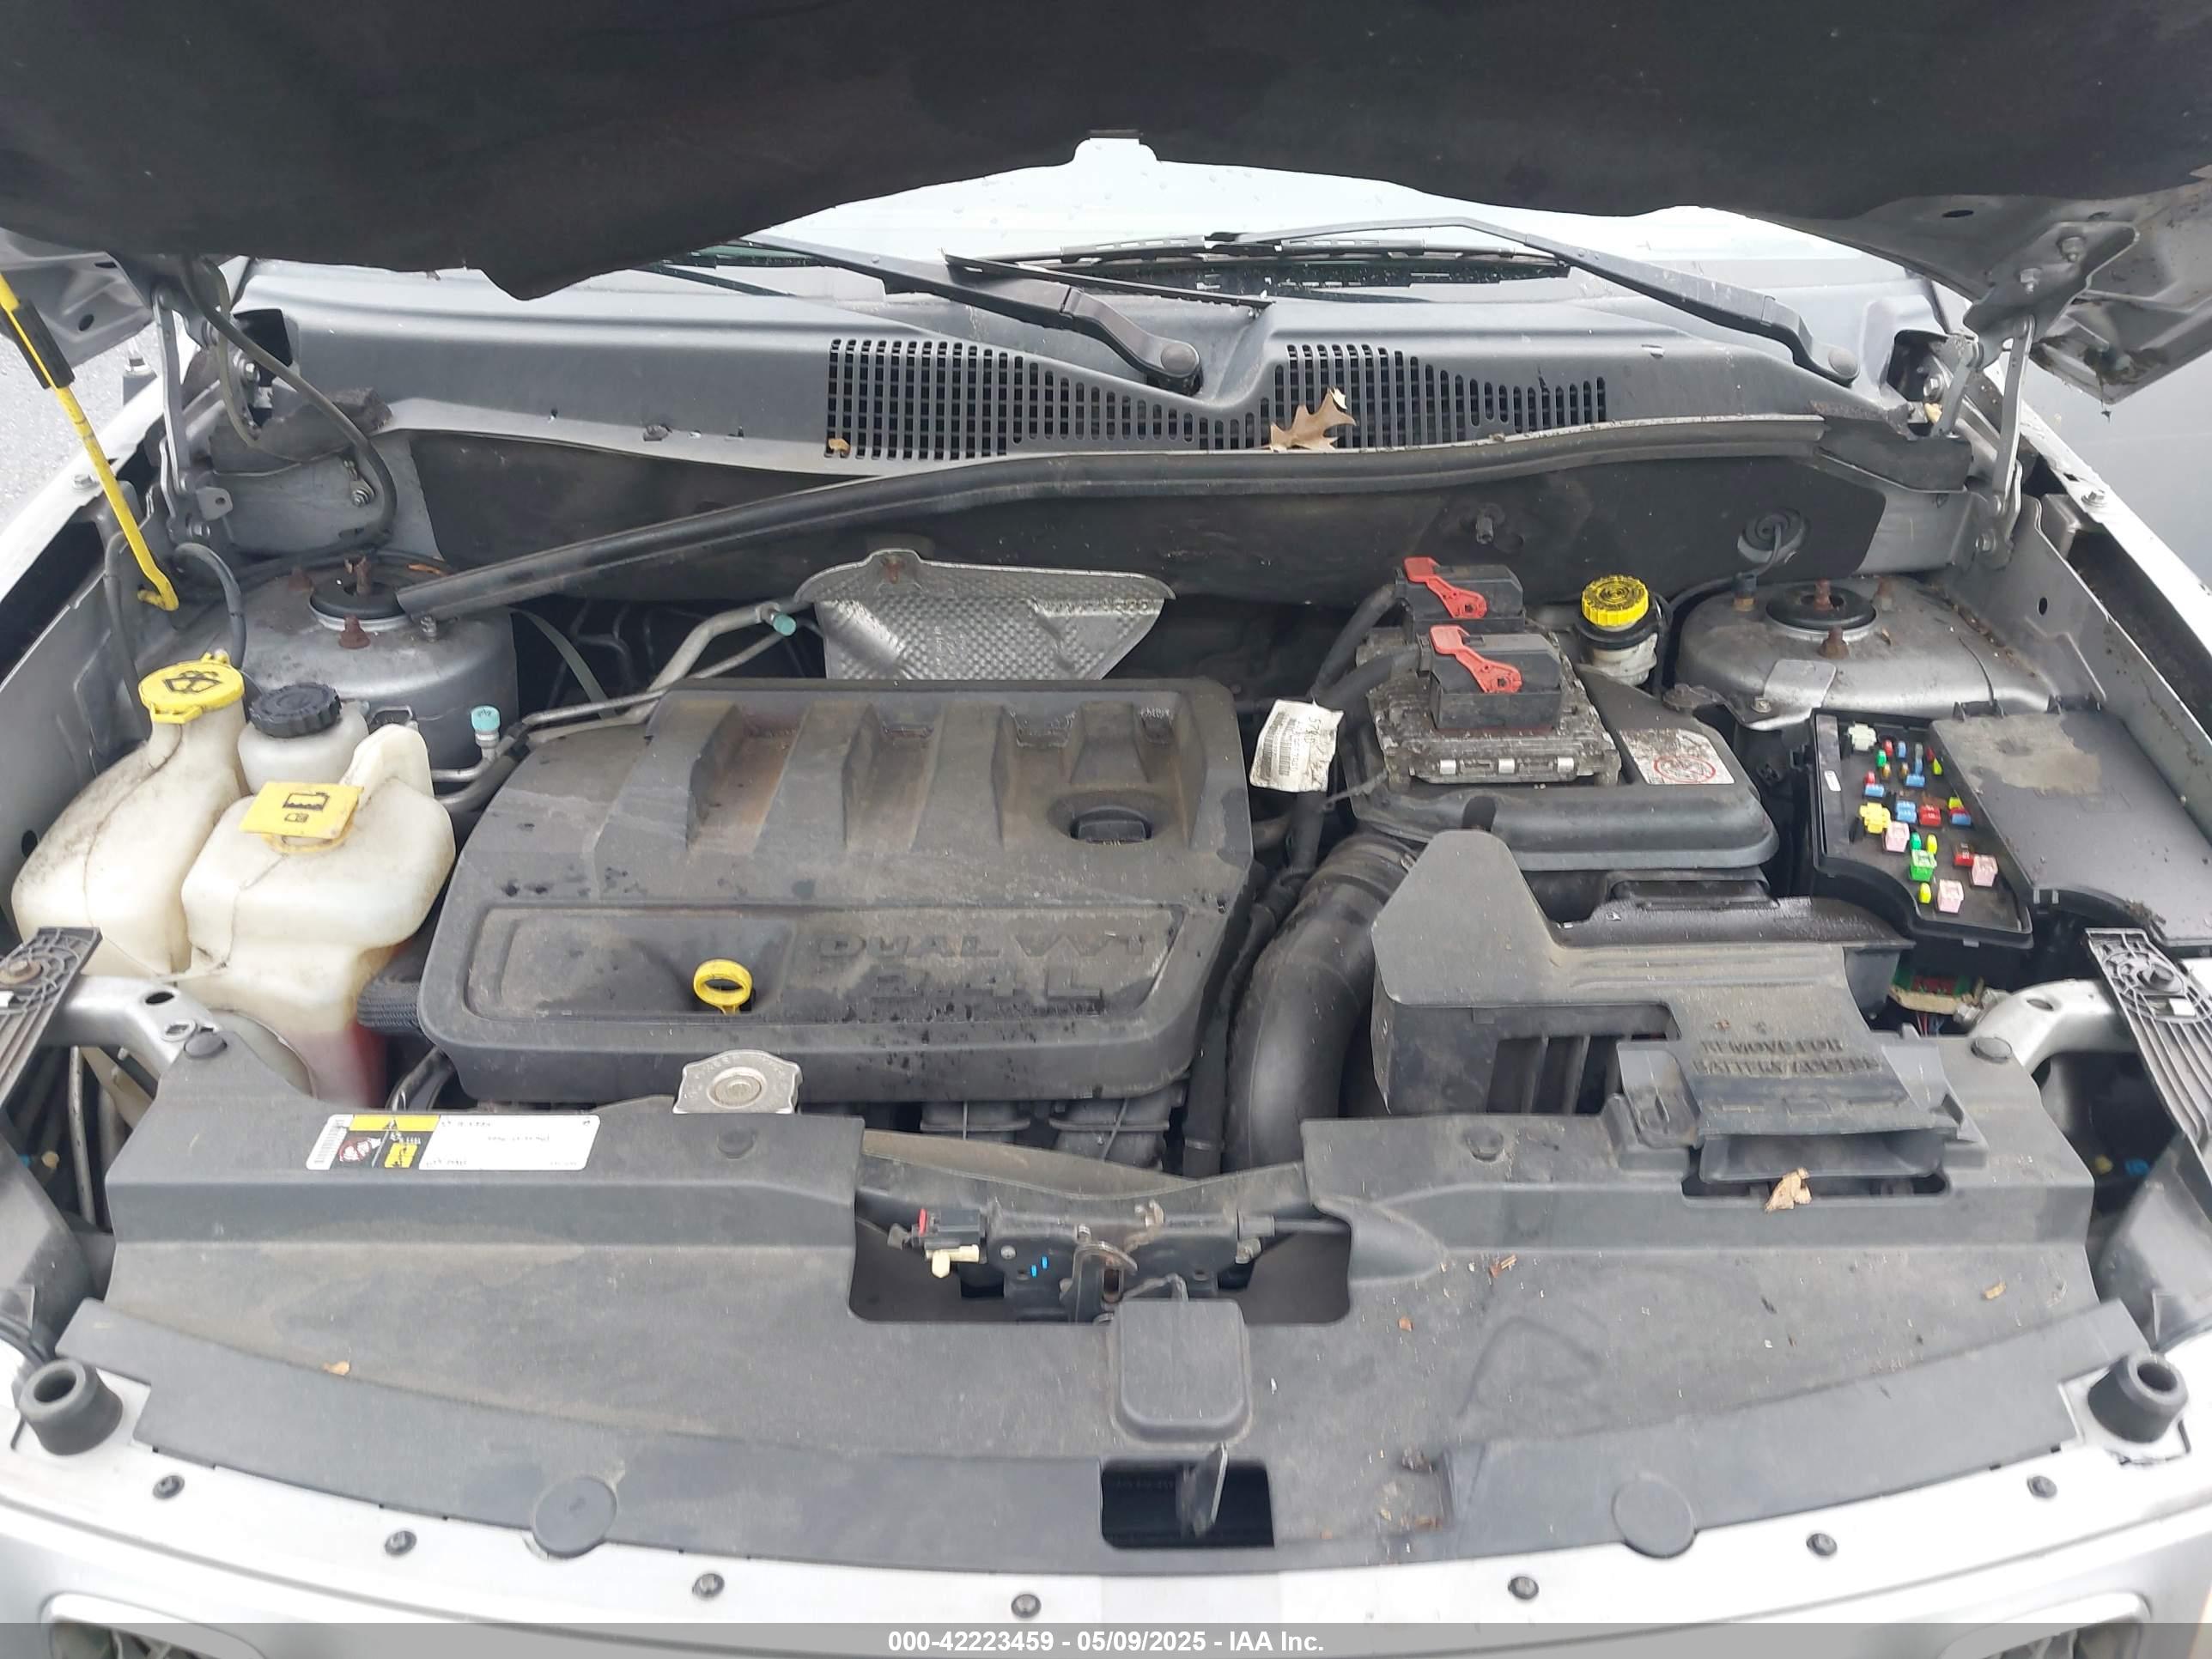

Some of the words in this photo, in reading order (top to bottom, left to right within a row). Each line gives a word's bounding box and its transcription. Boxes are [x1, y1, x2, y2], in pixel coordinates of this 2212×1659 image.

[818, 935, 1000, 959] DUAL
[1700, 1039, 1795, 1054] REMOVE
[1798, 1037, 1844, 1053] FOR
[1691, 1060, 1784, 1075] BATTERY
[1791, 1056, 1882, 1073] ACCESS
